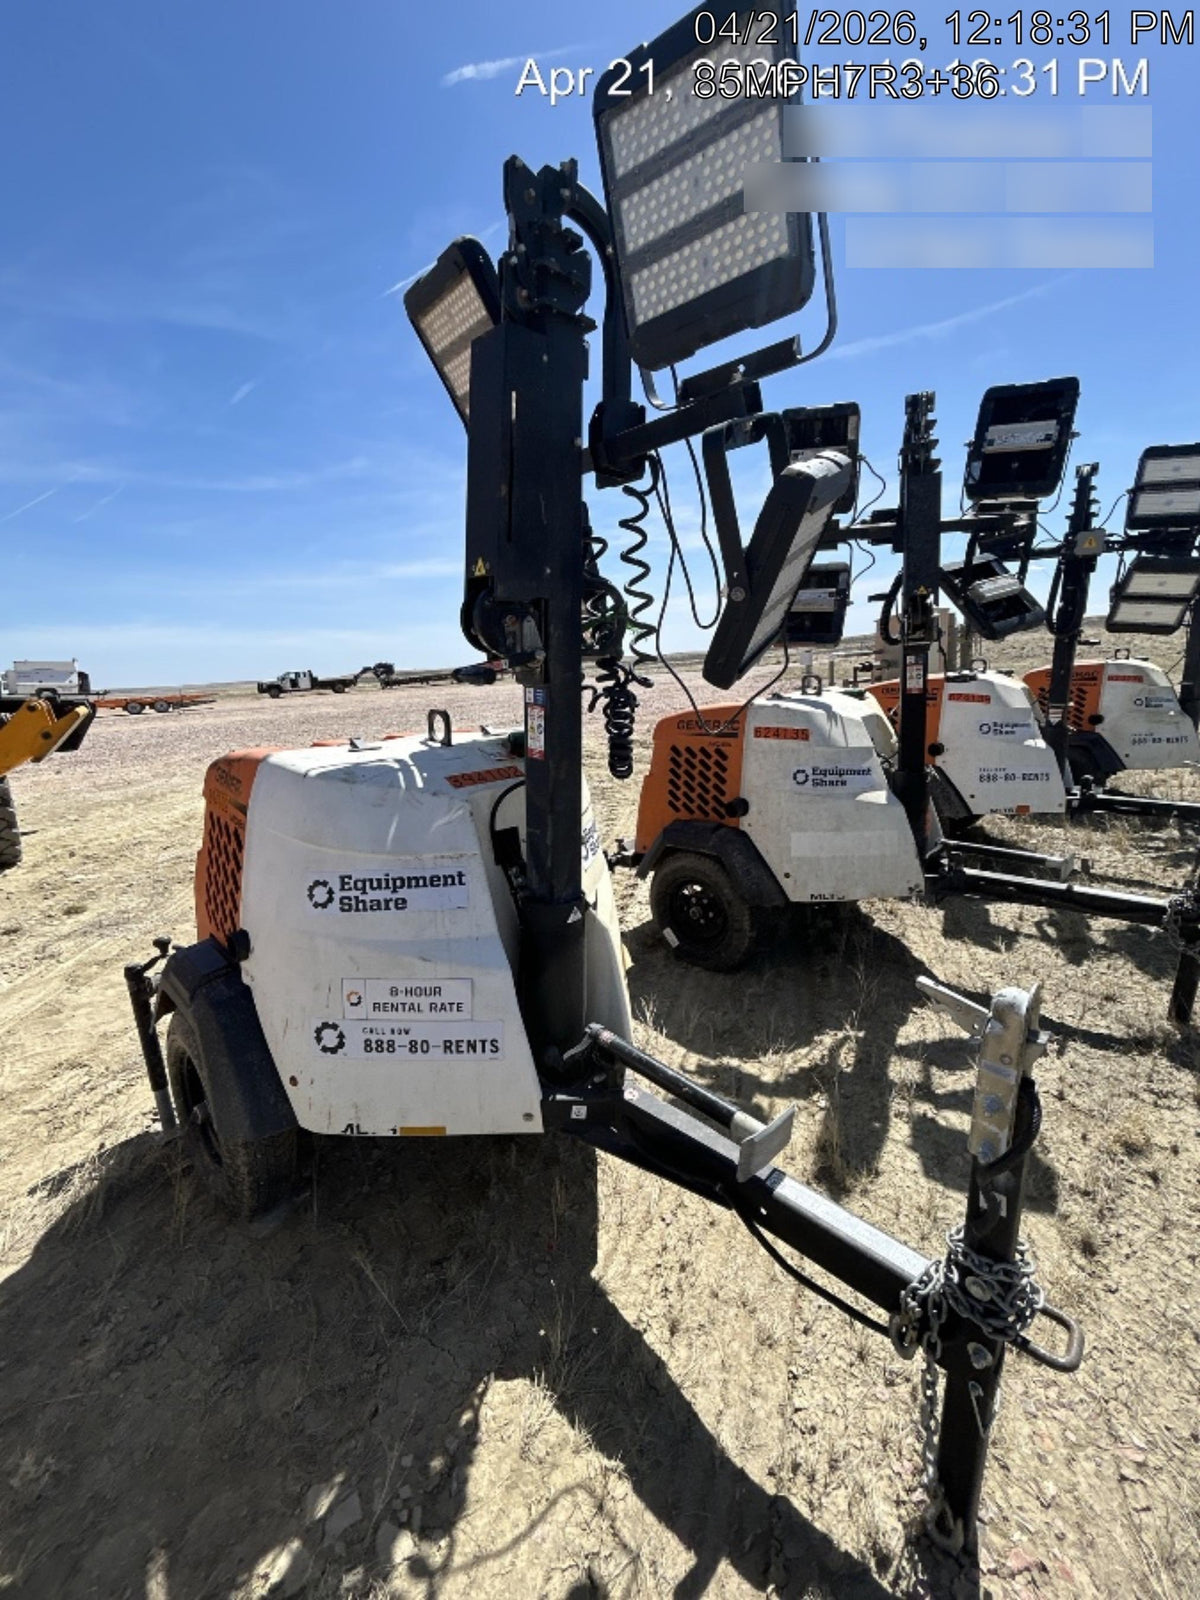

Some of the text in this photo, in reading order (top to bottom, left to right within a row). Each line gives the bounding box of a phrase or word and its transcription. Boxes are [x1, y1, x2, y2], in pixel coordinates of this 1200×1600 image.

[812, 766, 873, 778] Equipment
[812, 779, 847, 787] Share
[339, 871, 467, 894] Equipment
[339, 895, 408, 913] Share
[389, 986, 442, 998] 8-HOUR
[372, 1002, 464, 1013] RENTAL RATE
[363, 1038, 500, 1054] 888-80-RENTS
